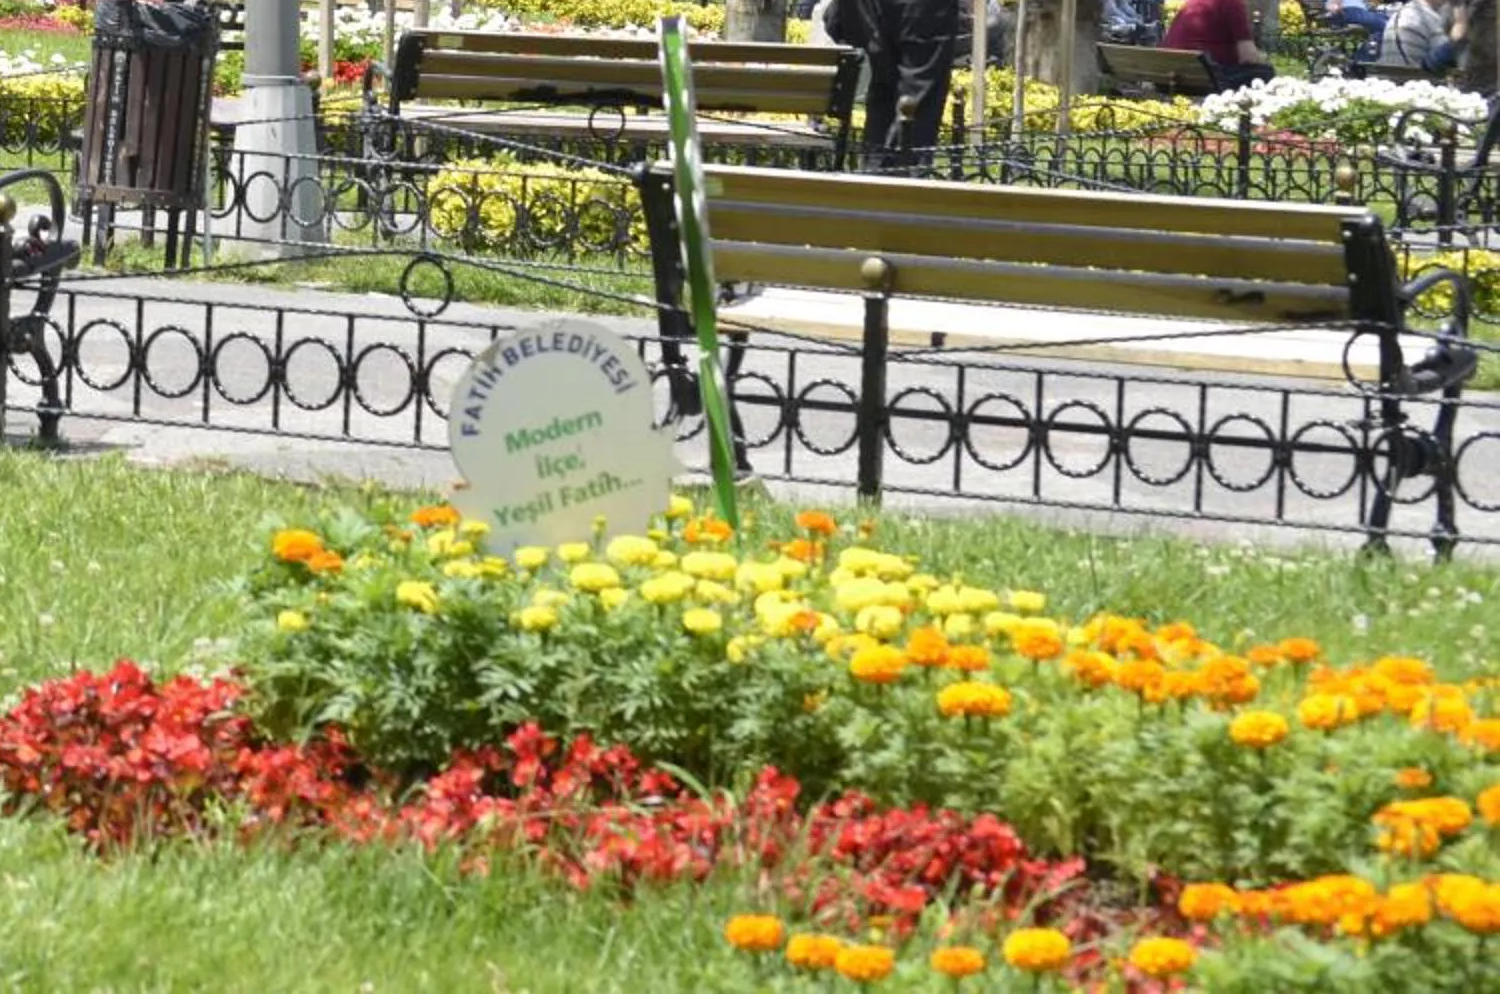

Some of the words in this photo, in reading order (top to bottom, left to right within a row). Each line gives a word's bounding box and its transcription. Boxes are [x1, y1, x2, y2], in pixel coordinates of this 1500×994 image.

[460, 363, 504, 438] FATİH
[501, 331, 639, 395] BELEDİYESİ
[503, 410, 604, 454] Modern
[493, 490, 553, 526] Yeşil
